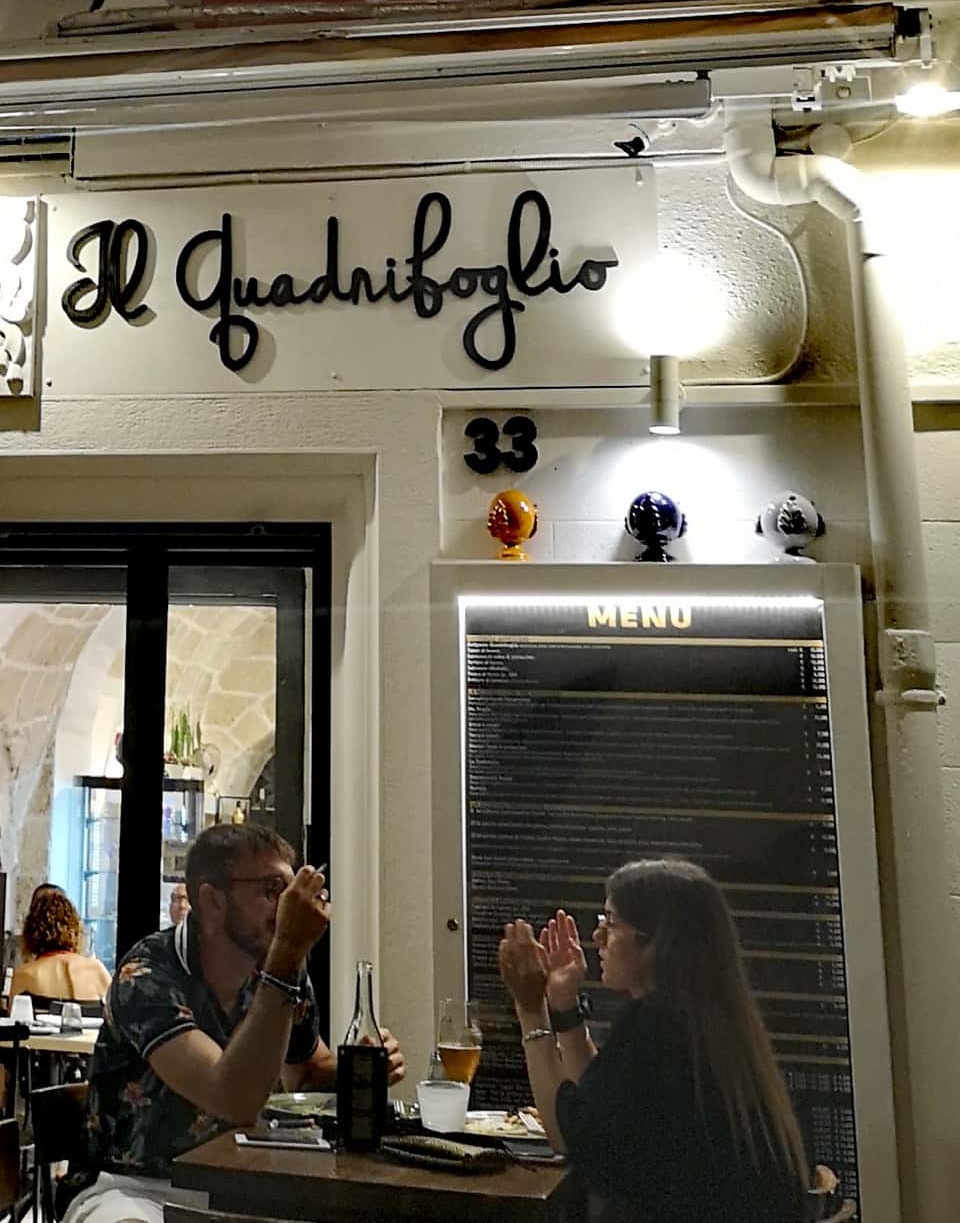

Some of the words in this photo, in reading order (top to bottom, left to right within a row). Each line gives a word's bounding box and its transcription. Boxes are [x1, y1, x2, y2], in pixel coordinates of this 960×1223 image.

[62, 218, 149, 325] Il
[176, 190, 619, 371] Quadrifoglio
[463, 416, 538, 474] 33
[587, 604, 692, 629] MENU
